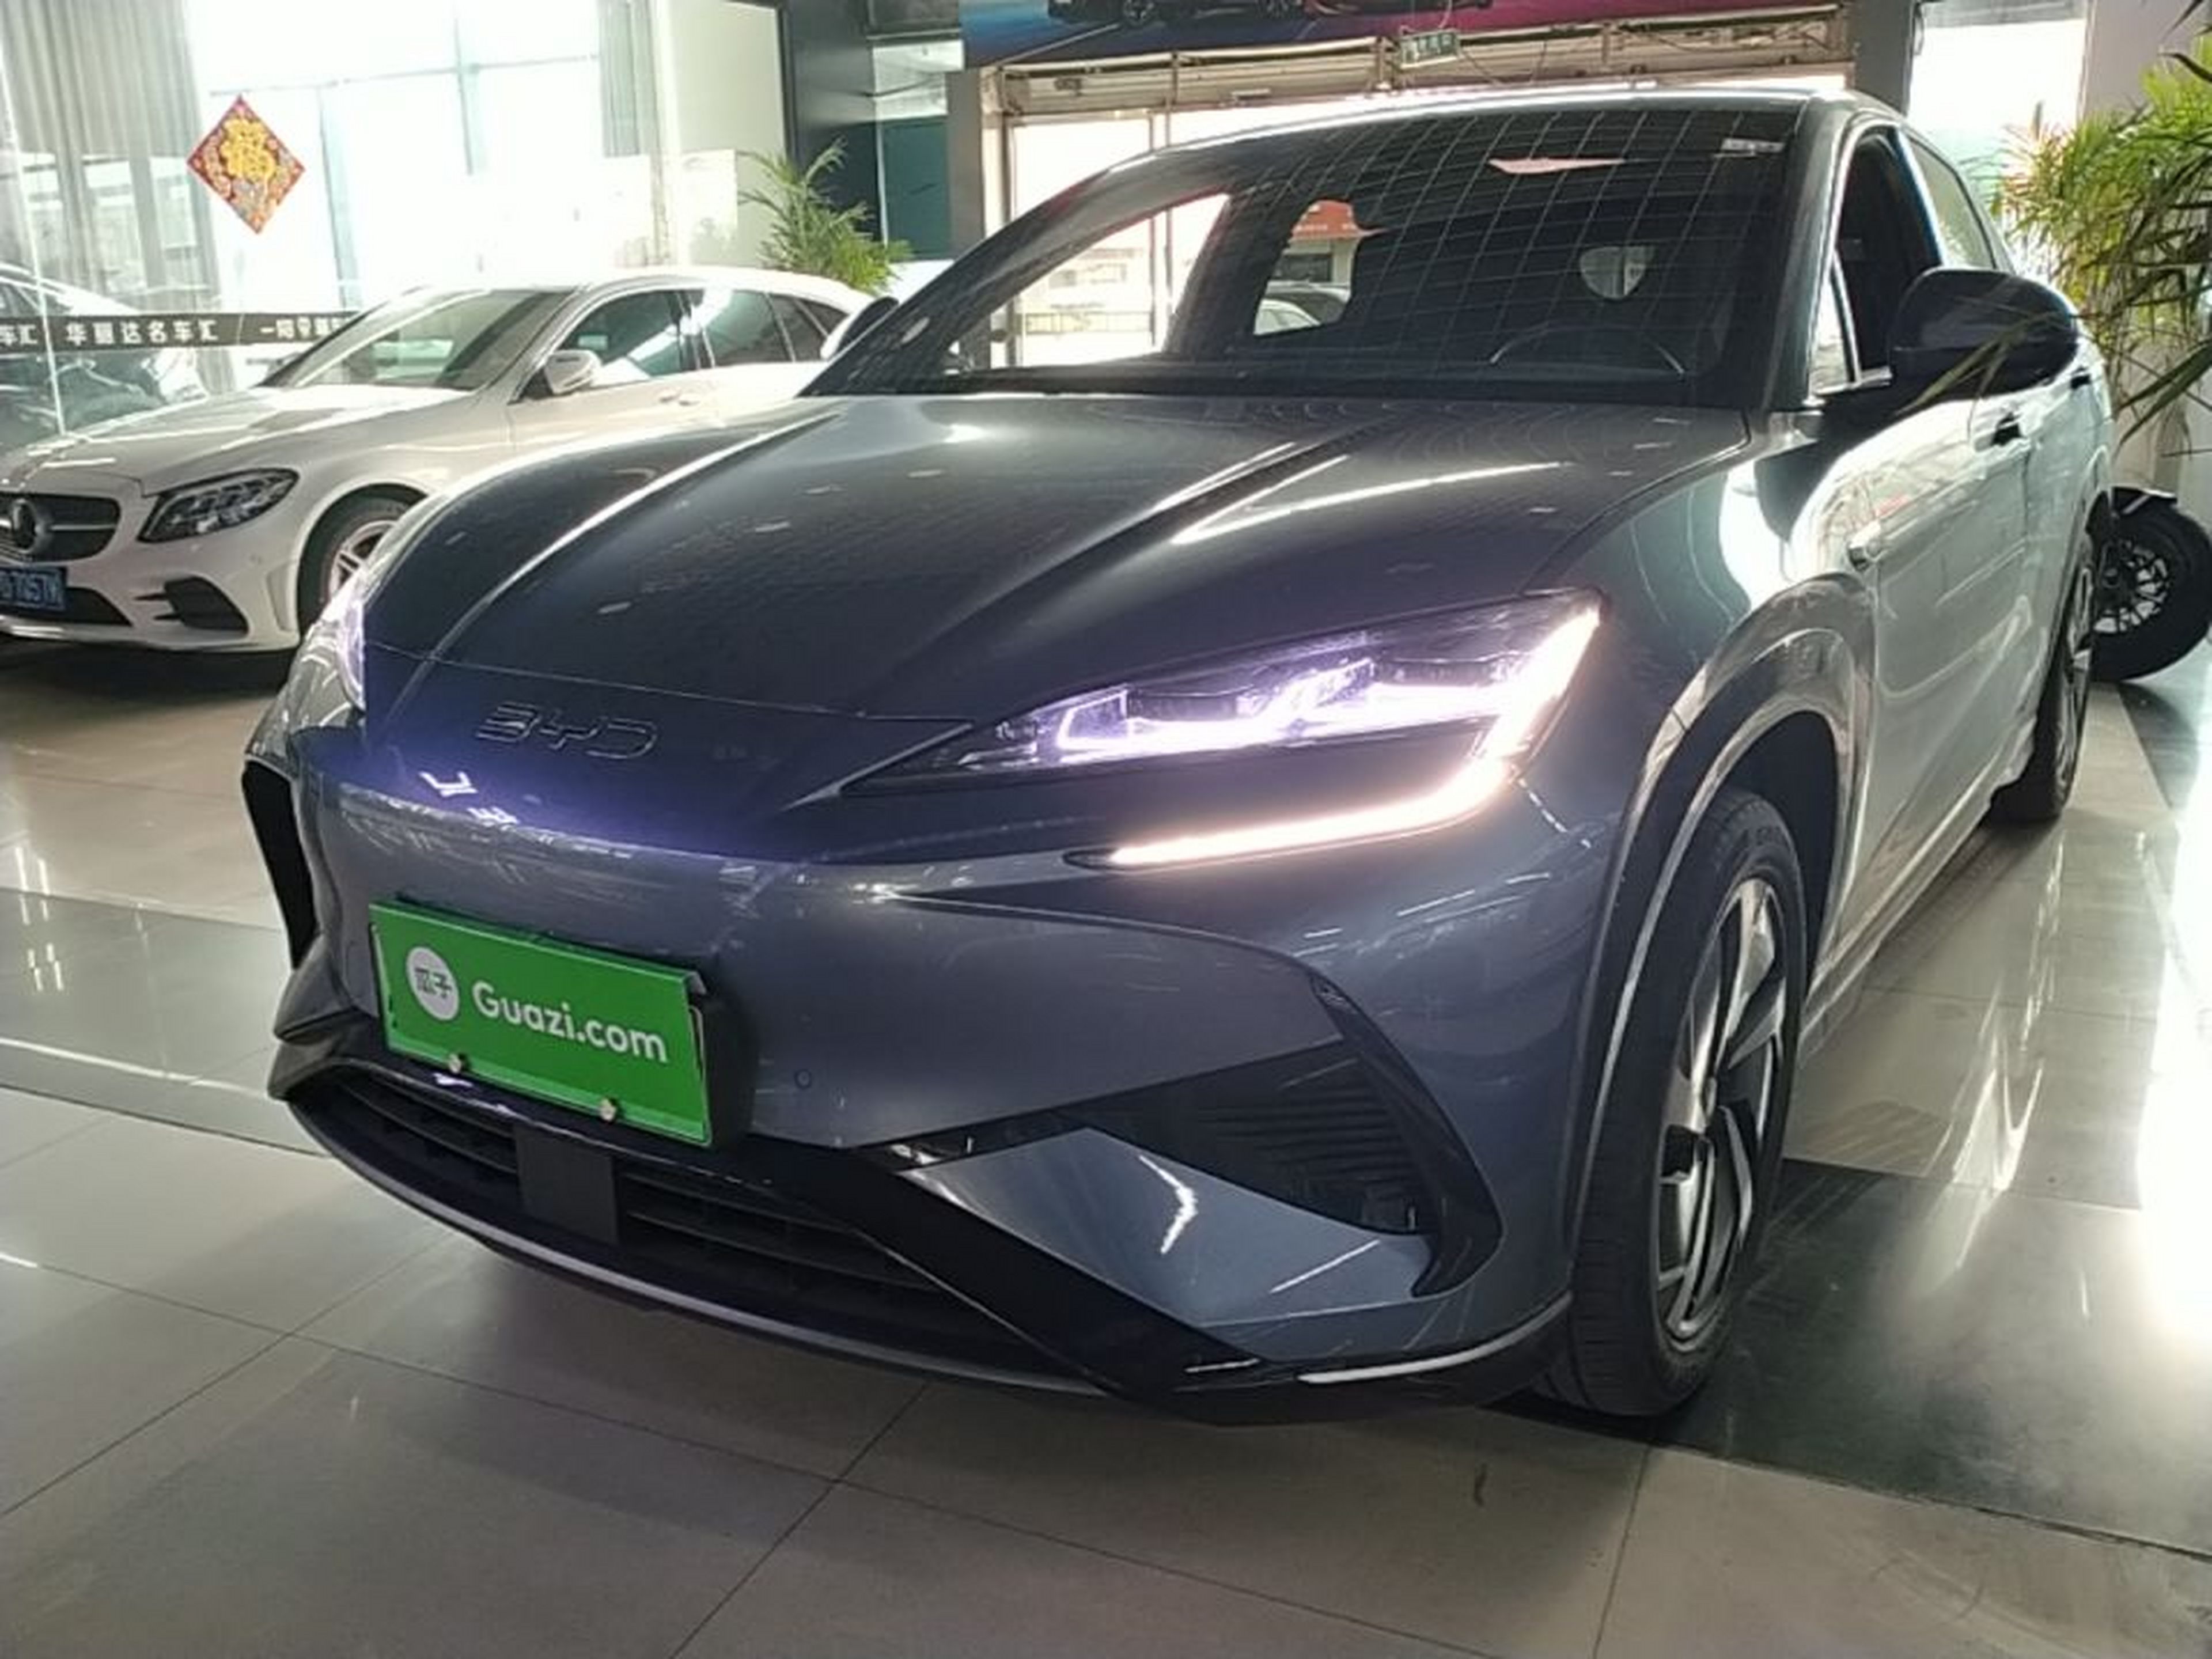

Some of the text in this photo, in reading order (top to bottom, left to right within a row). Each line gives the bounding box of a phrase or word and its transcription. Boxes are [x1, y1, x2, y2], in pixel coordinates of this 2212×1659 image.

[475, 700, 658, 759] BYD
[414, 966, 453, 999] 瓜子
[472, 980, 668, 1064] Guazi.com
